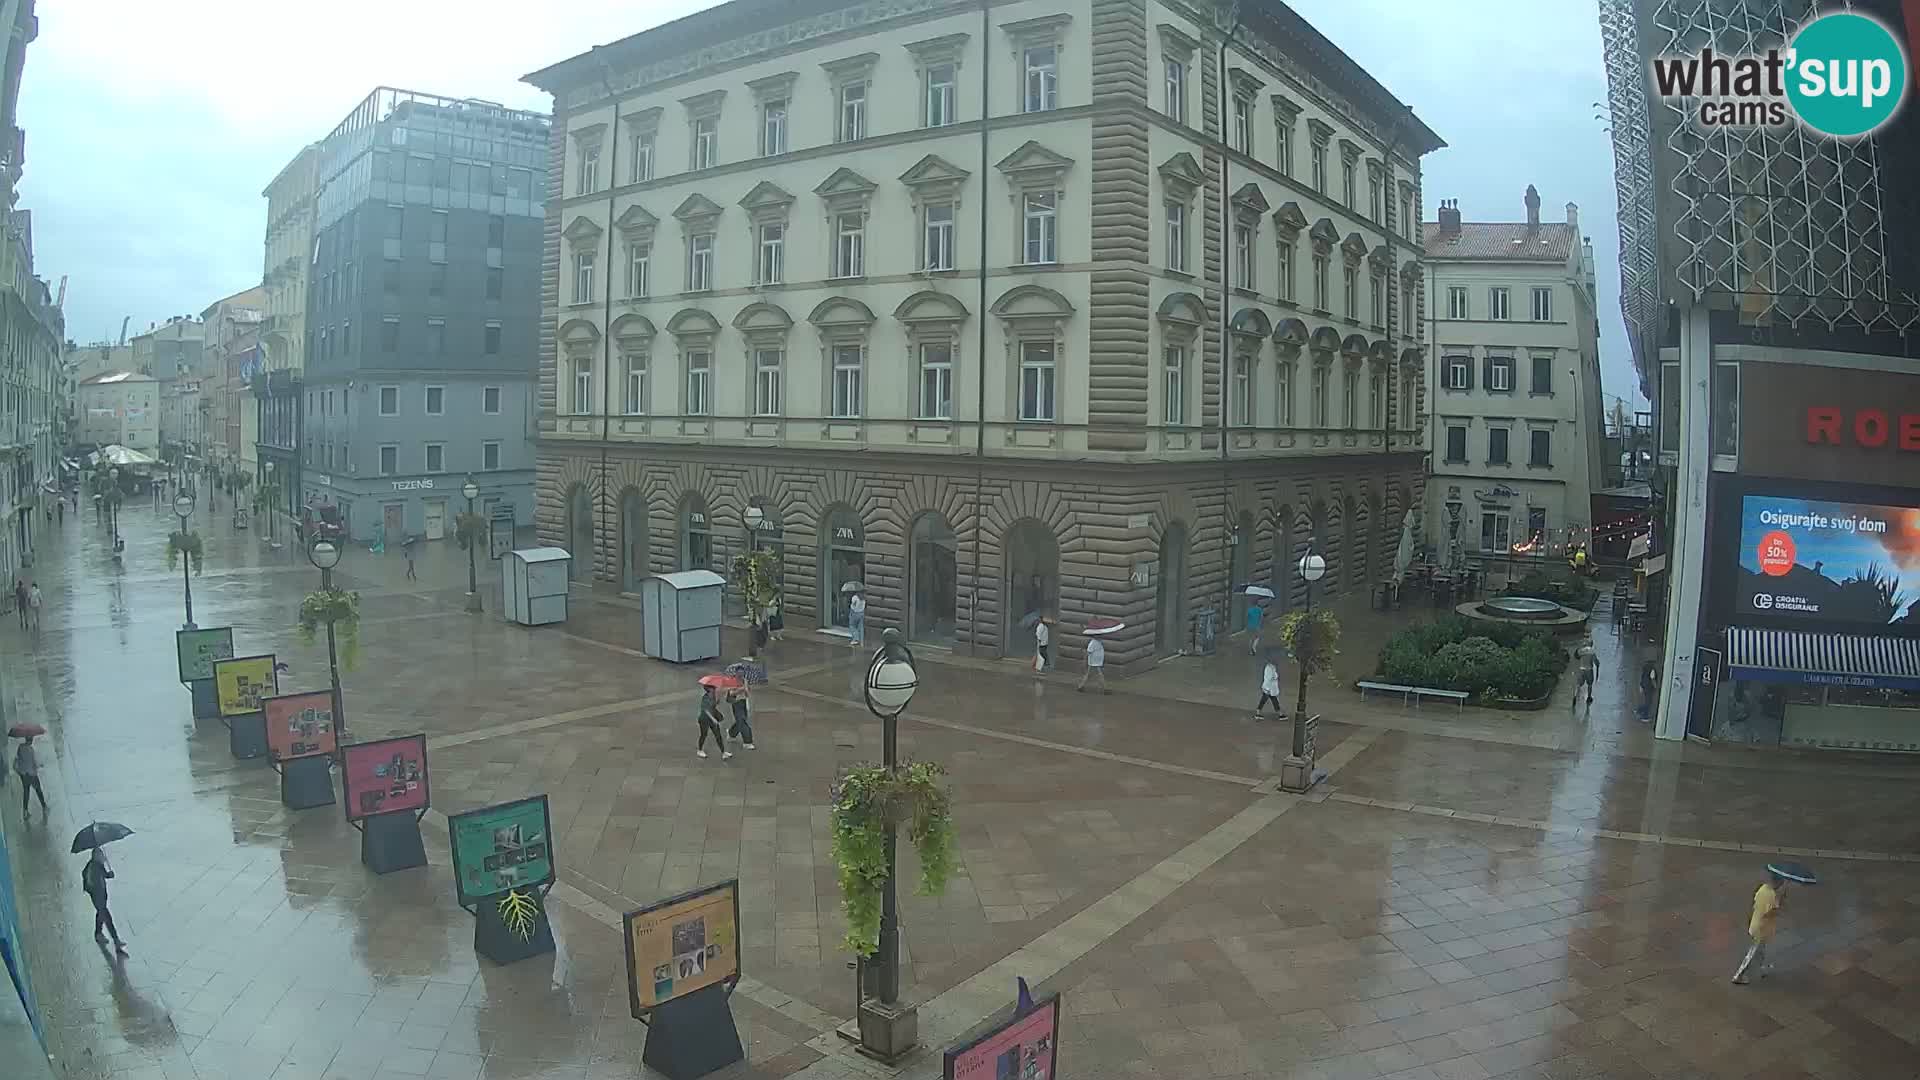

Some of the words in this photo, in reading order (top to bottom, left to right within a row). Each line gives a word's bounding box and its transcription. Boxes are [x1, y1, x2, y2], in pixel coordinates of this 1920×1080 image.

[392, 479, 434, 490] TEZENIS
[1760, 509, 1828, 532] Osigurajte
[1830, 515, 1856, 534] svoj
[1859, 517, 1887, 533] dom
[1767, 546, 1788, 558] 50%
